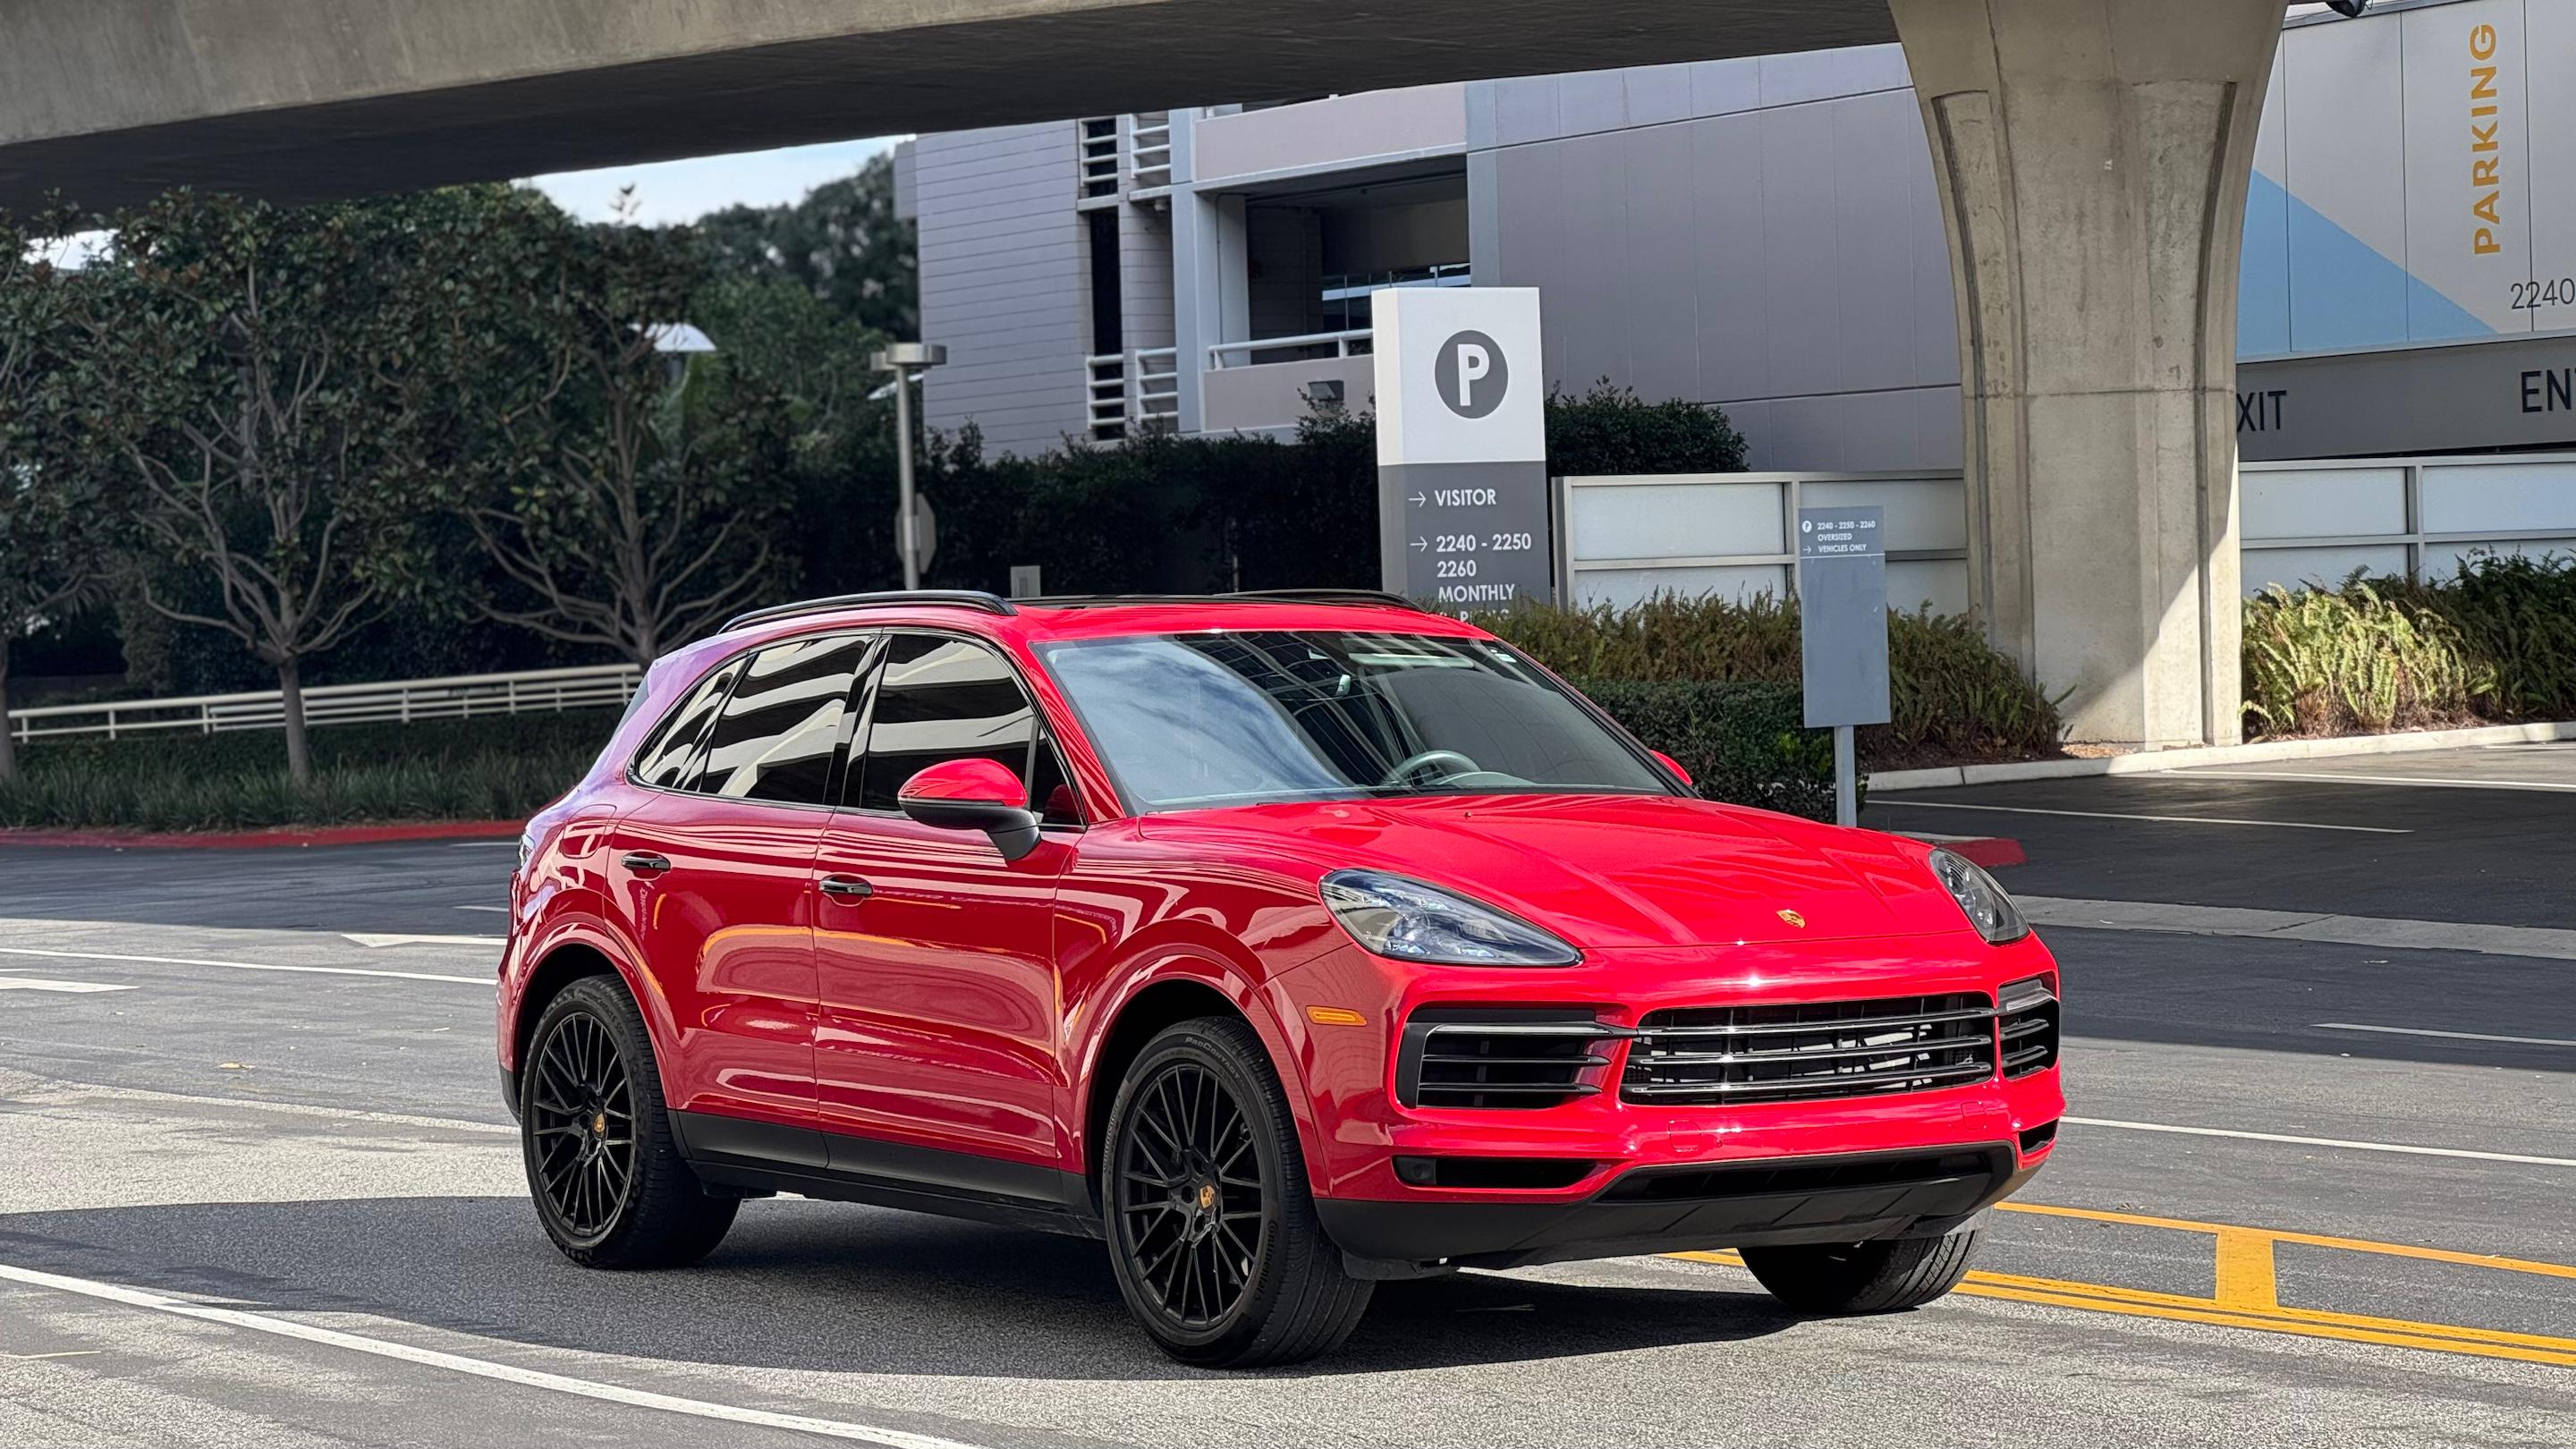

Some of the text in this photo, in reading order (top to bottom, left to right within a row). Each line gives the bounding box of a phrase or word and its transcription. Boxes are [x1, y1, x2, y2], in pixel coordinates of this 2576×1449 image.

[2469, 24, 2501, 255] PARKING
[2510, 278, 2576, 309] 2240
[1457, 343, 1489, 406] P
[2521, 368, 2576, 413] EN
[2236, 389, 2287, 433] XIT
[1435, 488, 1496, 507] VISITOR
[1817, 522, 1834, 530] 2240
[1838, 521, 1855, 530] 2250
[1860, 521, 1876, 529] 2260
[1436, 535, 1476, 553] 2240
[1492, 533, 1531, 552] 2250
[1818, 533, 1852, 541] OVERSIZED
[1818, 544, 1867, 553] VEHICLES ONLY
[1437, 560, 1477, 578] 2260
[1438, 583, 1515, 603] MONTHLY
